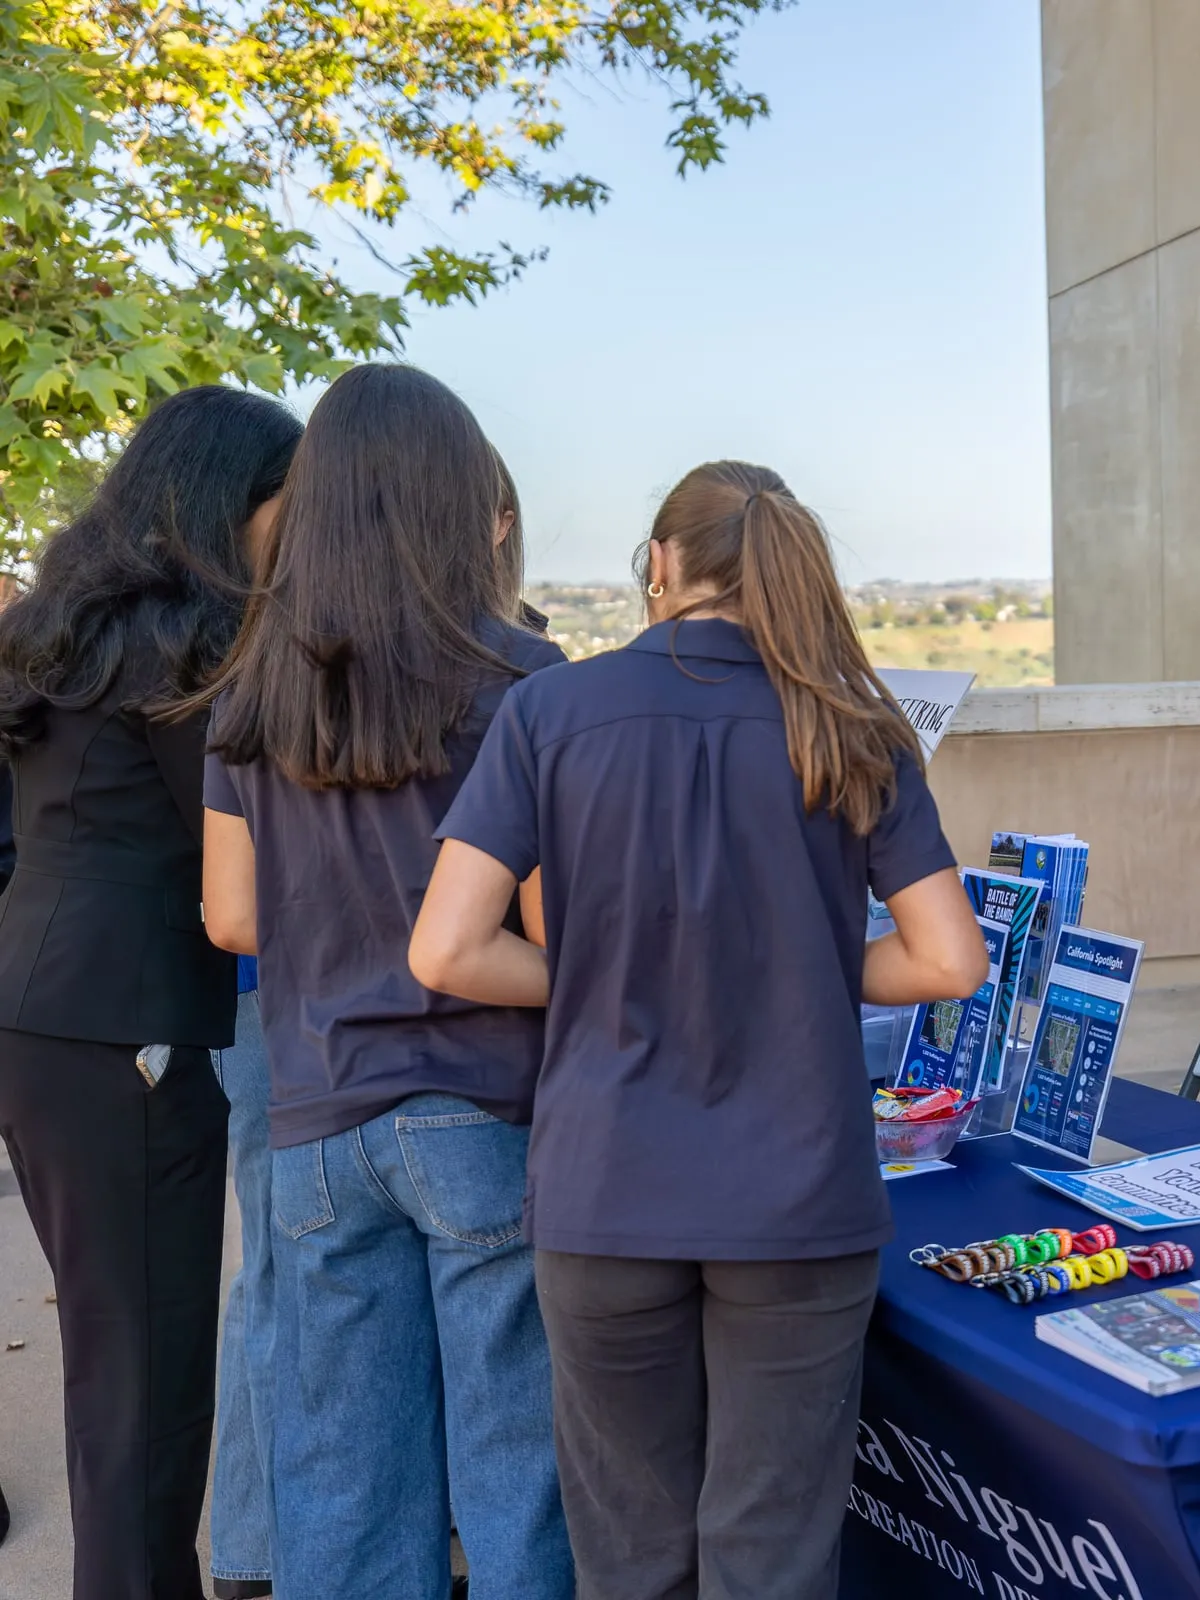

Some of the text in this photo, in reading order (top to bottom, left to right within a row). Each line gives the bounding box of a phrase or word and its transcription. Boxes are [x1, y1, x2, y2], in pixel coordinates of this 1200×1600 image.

[986, 888, 1019, 907] BATTLE OF
[983, 903, 1015, 922] THE BANDS
[1067, 945, 1123, 970] California Spotlight
[883, 1417, 1145, 1600] Niguel
[847, 1483, 985, 1596] CREATION
